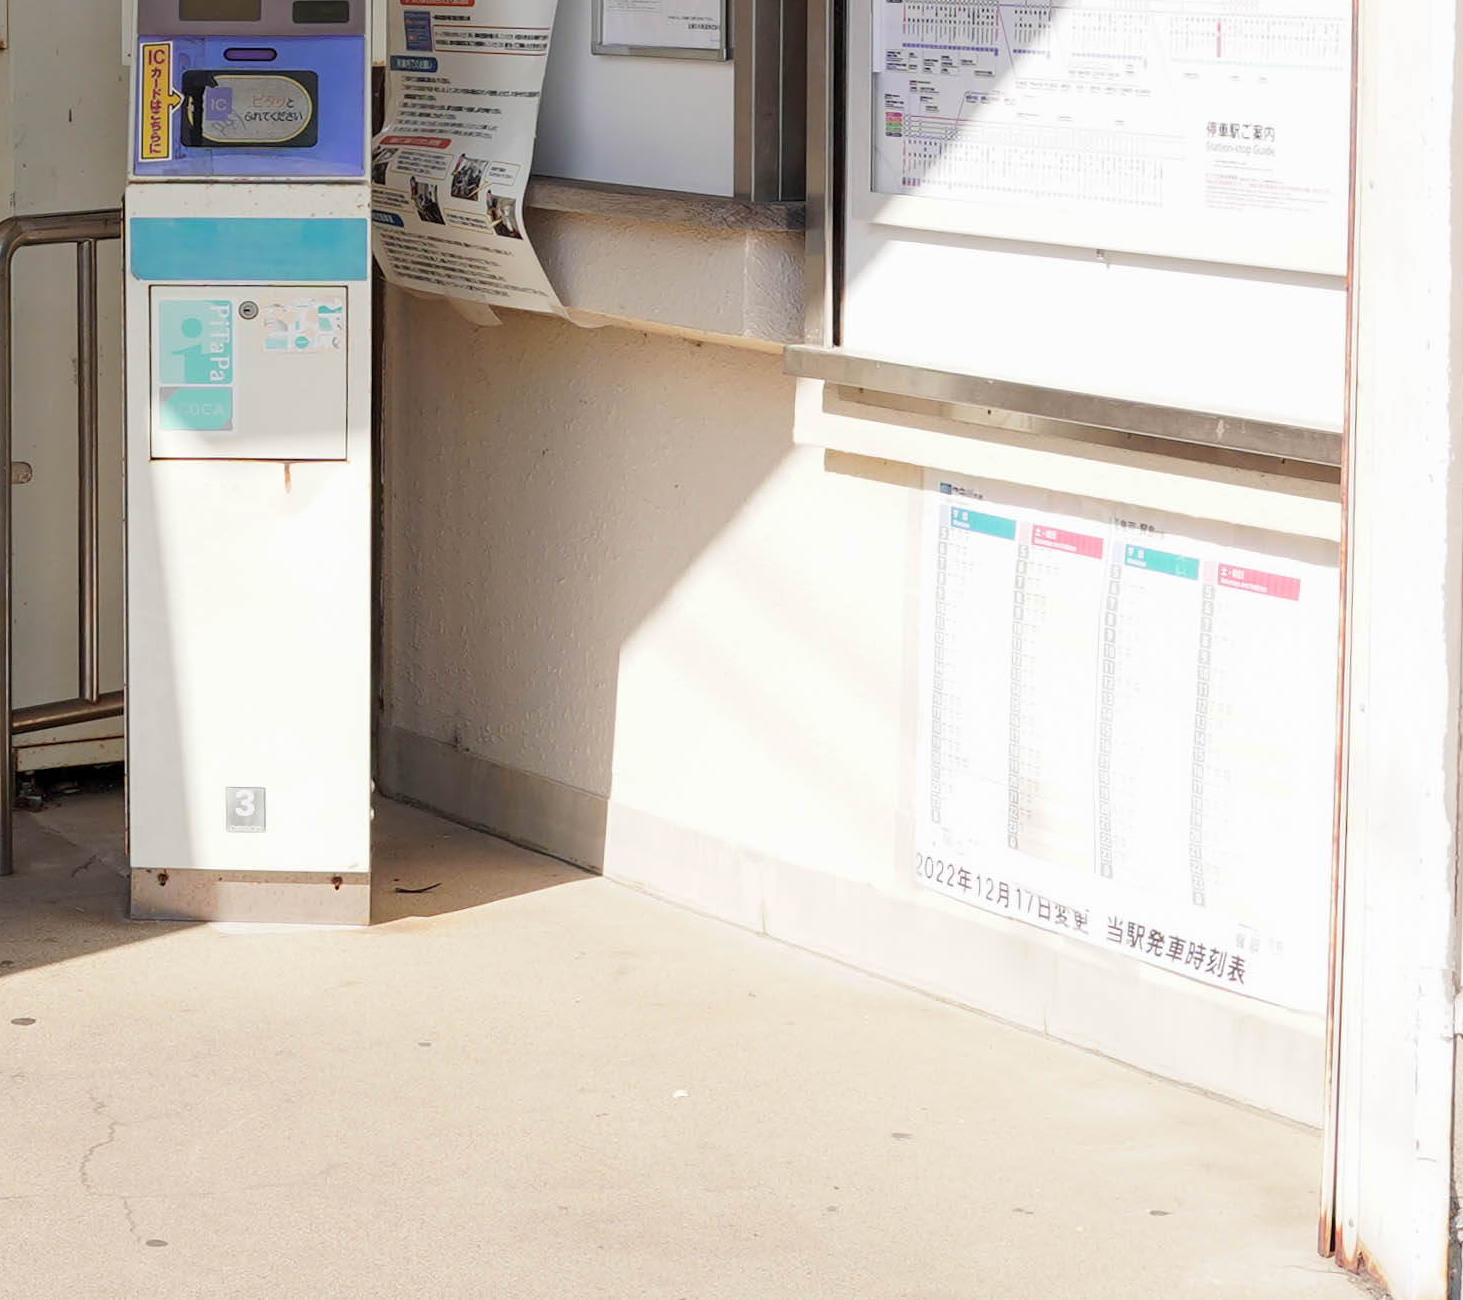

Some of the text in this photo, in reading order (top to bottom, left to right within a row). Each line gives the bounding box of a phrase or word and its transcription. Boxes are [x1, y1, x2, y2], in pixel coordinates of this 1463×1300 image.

[210, 97, 228, 112] IC
[243, 110, 305, 123] ふれてください
[235, 789, 255, 817] 3
[1106, 915, 1248, 986] 当駅発車時刻表
